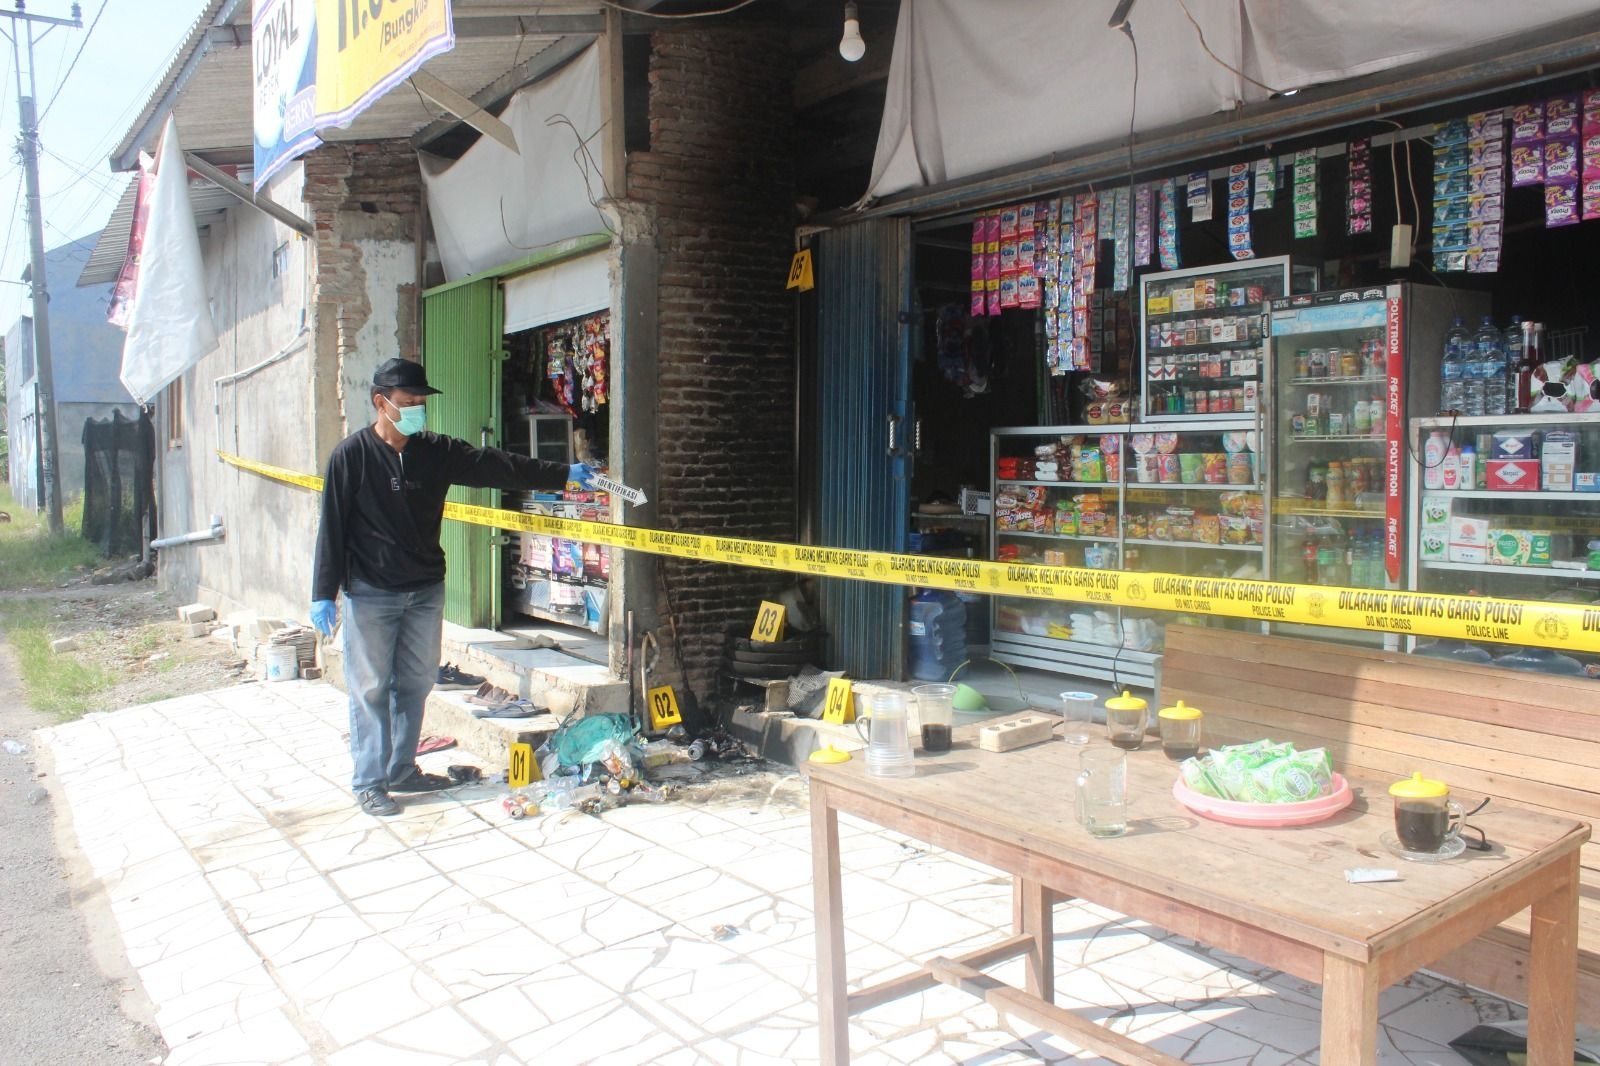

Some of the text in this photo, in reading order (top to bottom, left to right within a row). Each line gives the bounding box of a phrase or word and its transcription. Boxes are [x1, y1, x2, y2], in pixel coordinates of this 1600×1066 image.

[257, 0, 299, 87] LOYAL
[1390, 298, 1398, 354] POLYTRON
[1390, 440, 1398, 496] POLYTRON
[597, 478, 638, 500] IDENTIFIKASI
[716, 540, 733, 552] DILARANG
[734, 542, 752, 554] MELINTAS
[753, 544, 764, 556] GARIS
[795, 548, 868, 567] DILARANG MELINTAS GARIS POLISI
[891, 557, 980, 578] DILARANG MELINTAS GARIS POLISI
[1008, 566, 1120, 590] DILARANG MELINTAS GARIS POLISI
[1086, 591, 1112, 601] POLICE LINE
[1154, 578, 1295, 605] DILARANG MELINTAS GARIS POLISI
[1175, 599, 1211, 610] DO NOT CROSS
[1252, 605, 1285, 618] POLICE LINE
[1339, 591, 1524, 625] DILARANG MELINTAS GARIS POLISI
[758, 608, 777, 636] 03
[1366, 616, 1412, 630] DO NOT CROSS
[1466, 625, 1509, 639] POLICE LINE
[655, 692, 674, 718] 02
[830, 686, 844, 715] 04
[514, 750, 525, 781] 01
